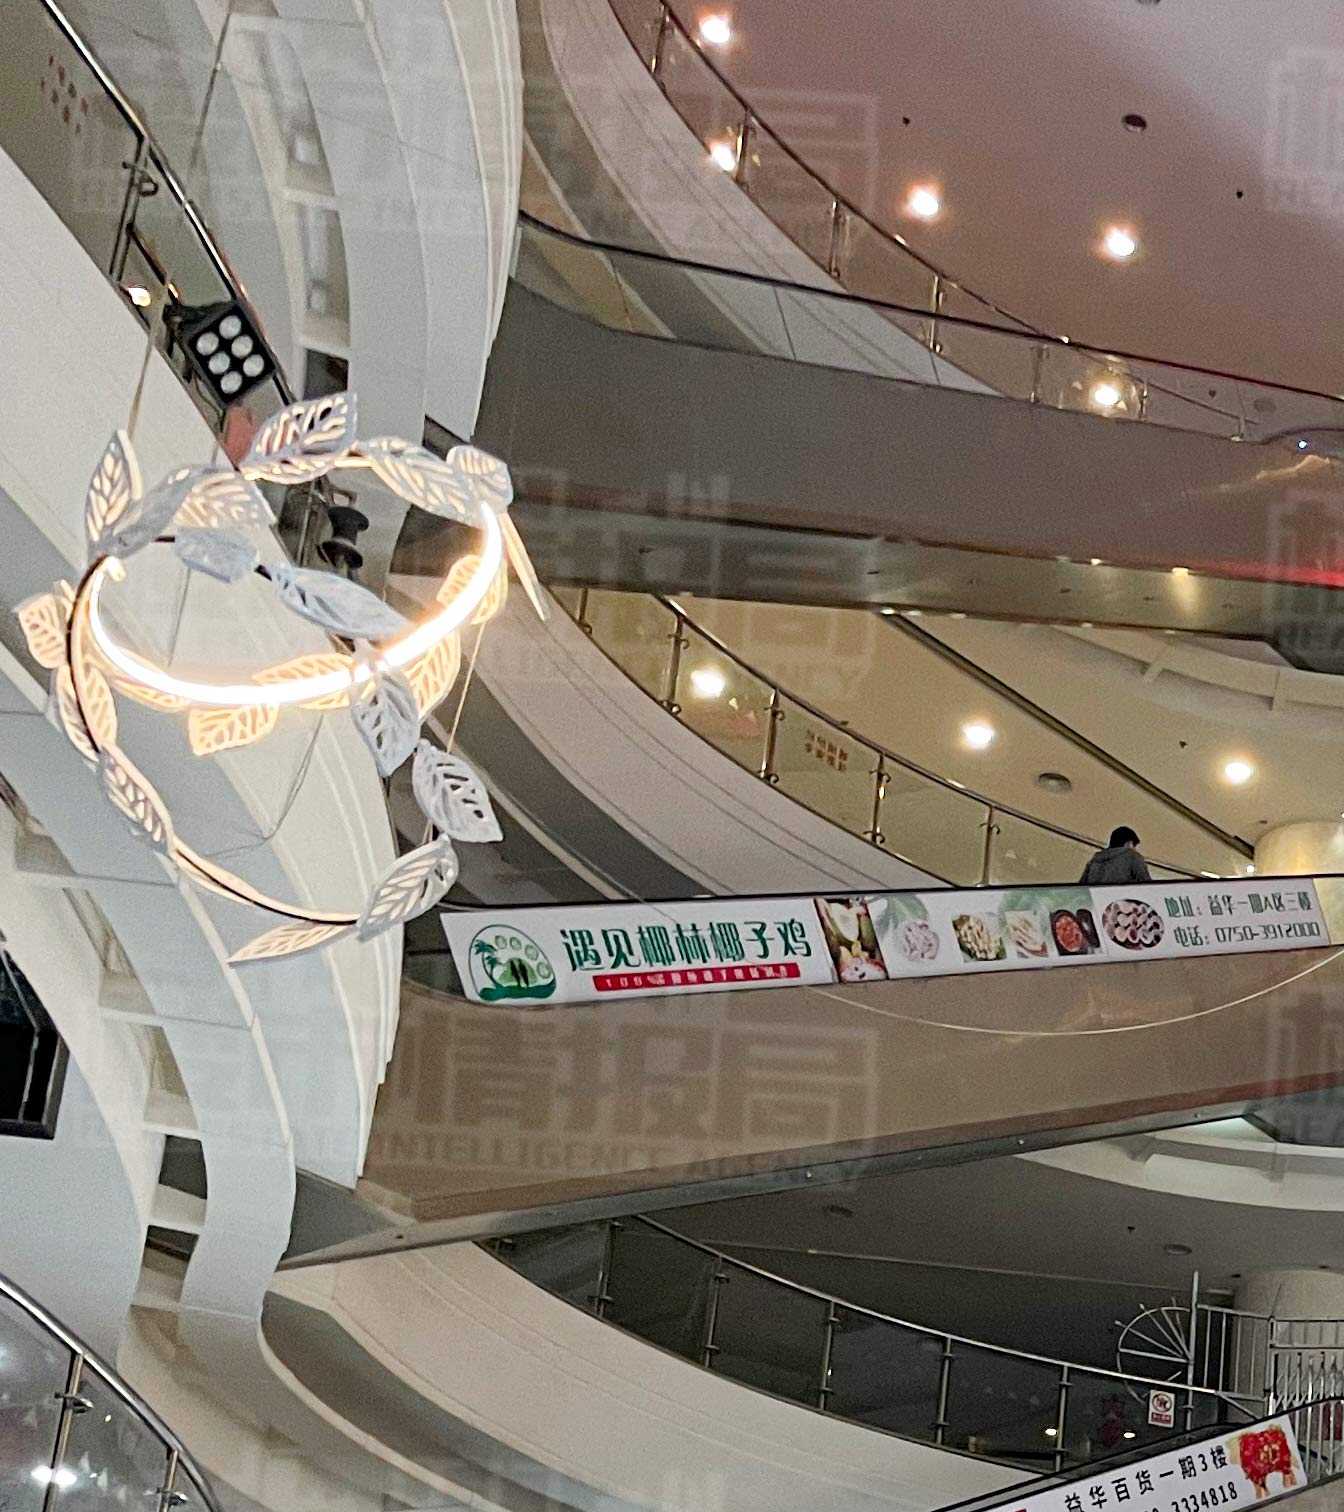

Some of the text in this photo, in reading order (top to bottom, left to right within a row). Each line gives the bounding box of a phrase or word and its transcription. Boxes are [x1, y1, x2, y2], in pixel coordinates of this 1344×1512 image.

[560, 918, 812, 971] 遇见椰林椰子鸡
